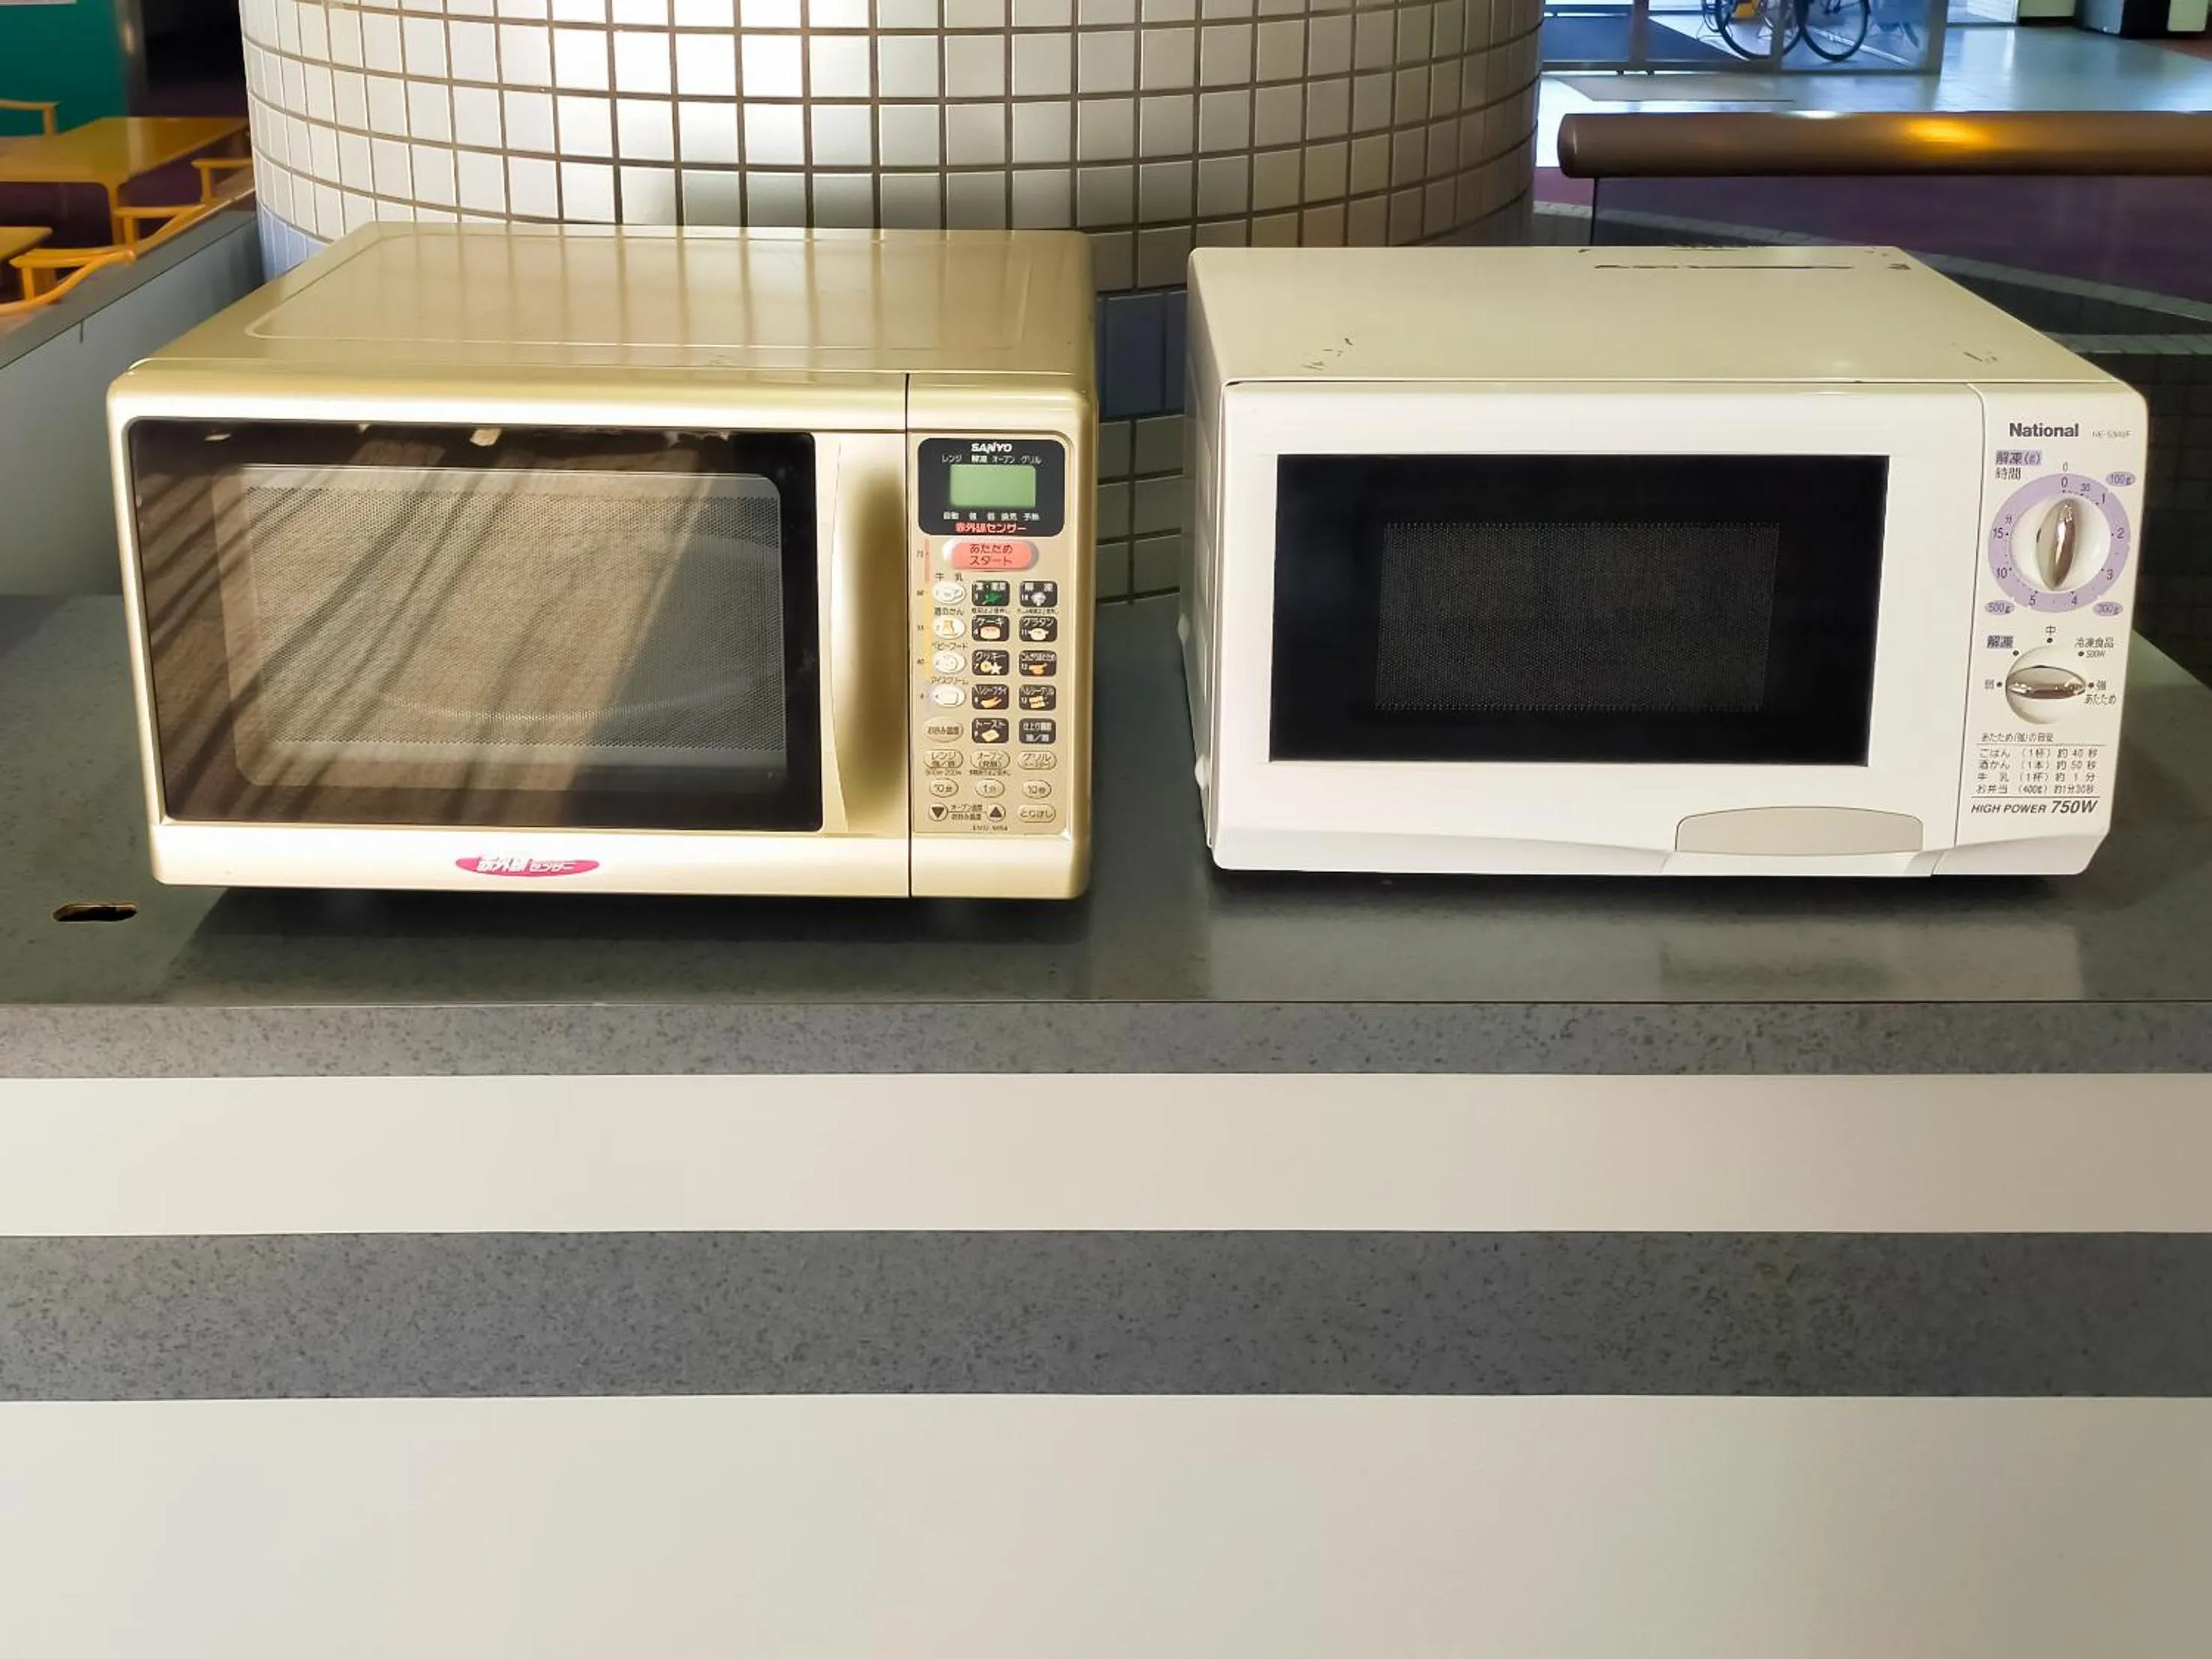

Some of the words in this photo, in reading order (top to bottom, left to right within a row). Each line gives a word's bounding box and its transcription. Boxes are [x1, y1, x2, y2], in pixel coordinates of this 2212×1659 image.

[2009, 422, 2079, 437] National
[971, 442, 1012, 454] SANYO
[942, 454, 962, 463] レンジ
[1995, 467, 2021, 480] 時間
[2111, 473, 2132, 485] 100g
[2061, 476, 2068, 488] 0
[1993, 527, 2003, 539] 15
[2117, 527, 2124, 539] 2
[969, 543, 1013, 554] あたため
[969, 555, 1012, 566] スタート
[1997, 567, 2007, 579] 10
[2107, 569, 2114, 580] 3
[2029, 595, 2036, 606] 5
[2072, 596, 2078, 605] 4
[2045, 626, 2056, 636] 中
[2075, 637, 2114, 648] 冷凍食品
[2084, 693, 2117, 705] あたため
[1971, 804, 2001, 813] HIGH
[2003, 804, 2047, 813] POWER
[2051, 800, 2099, 814] 750W
